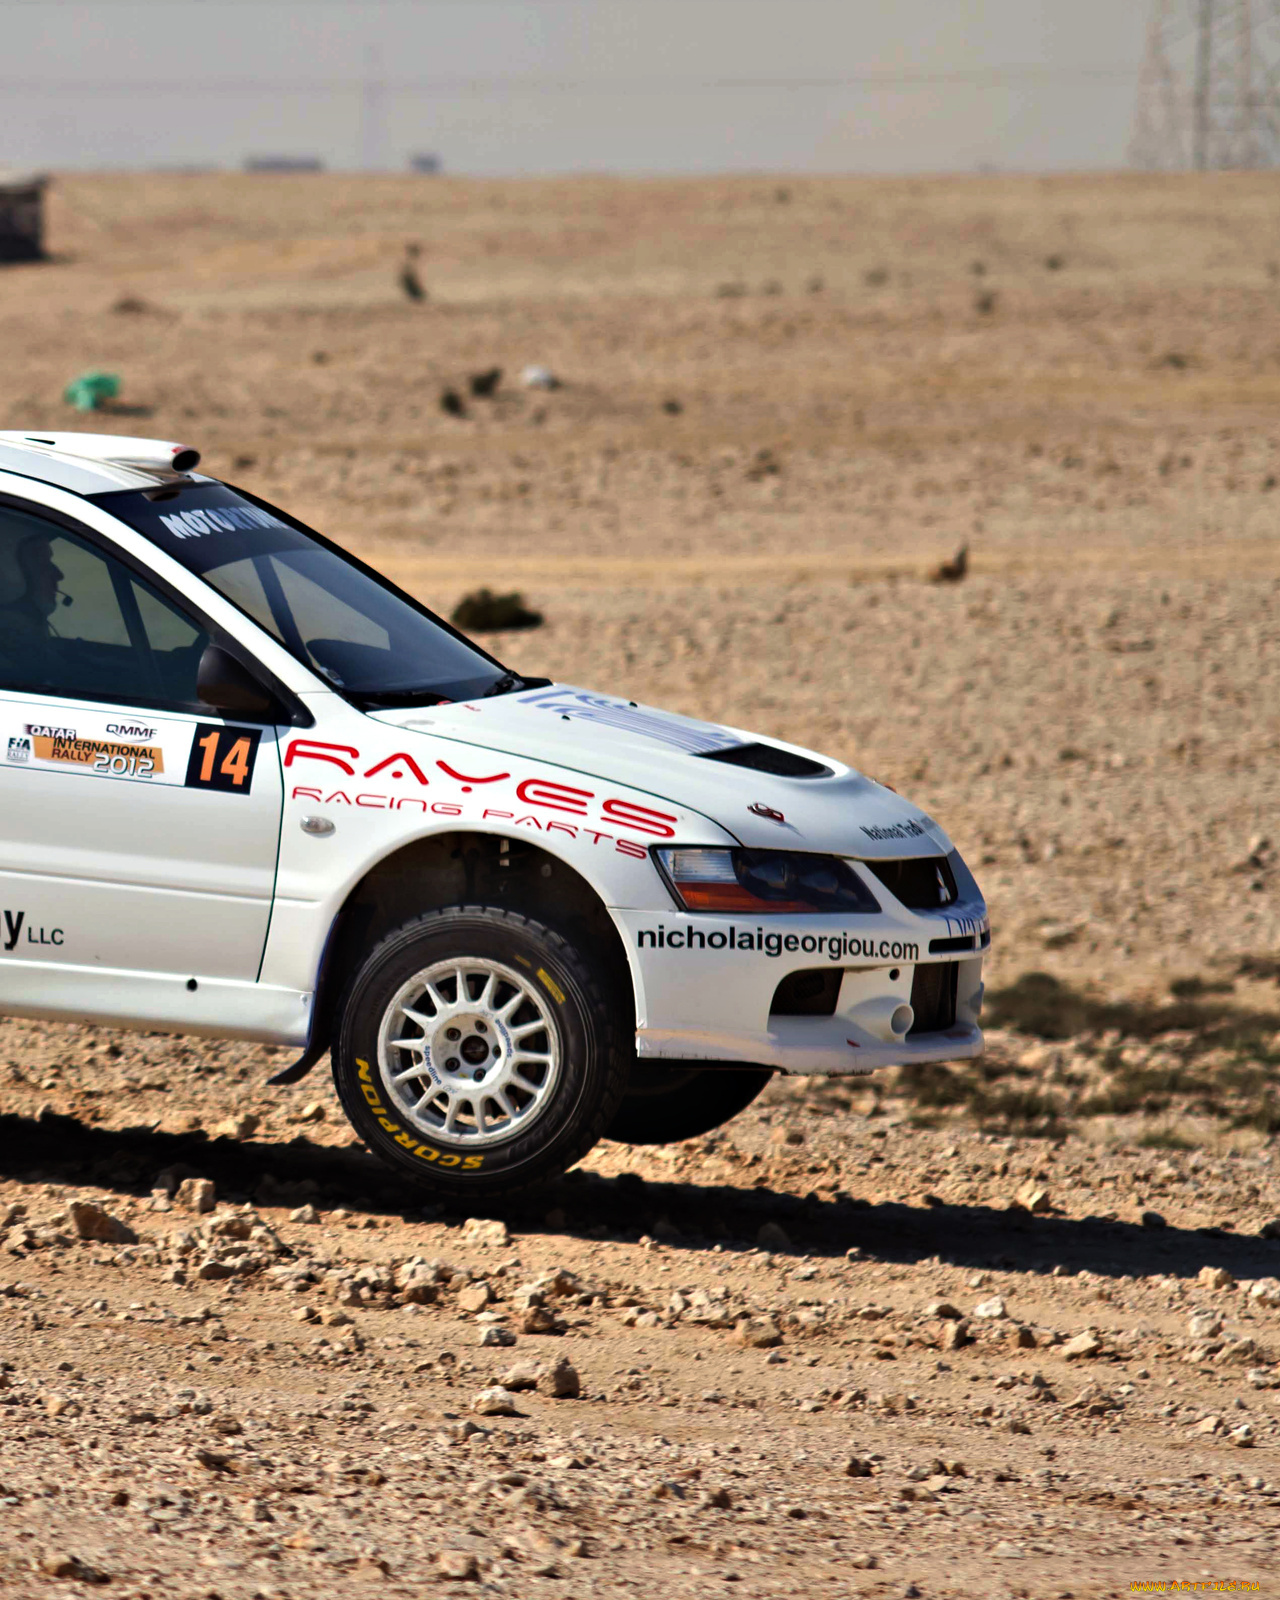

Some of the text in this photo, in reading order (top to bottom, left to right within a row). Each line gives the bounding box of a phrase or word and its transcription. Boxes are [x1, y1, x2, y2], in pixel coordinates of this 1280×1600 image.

[30, 725, 77, 741] QATAR
[53, 738, 155, 759] INTERNATIONAL
[106, 723, 158, 739] QMMF
[51, 749, 154, 778] RALLY 2012
[199, 731, 251, 785] 14
[284, 739, 677, 838] RAYES
[292, 786, 648, 860] RACING PARTS
[28, 926, 65, 946] LLC
[637, 924, 919, 961] nicholaigeorgiou.com
[424, 1045, 442, 1085] speedline
[355, 1057, 485, 1170] SCORPION
